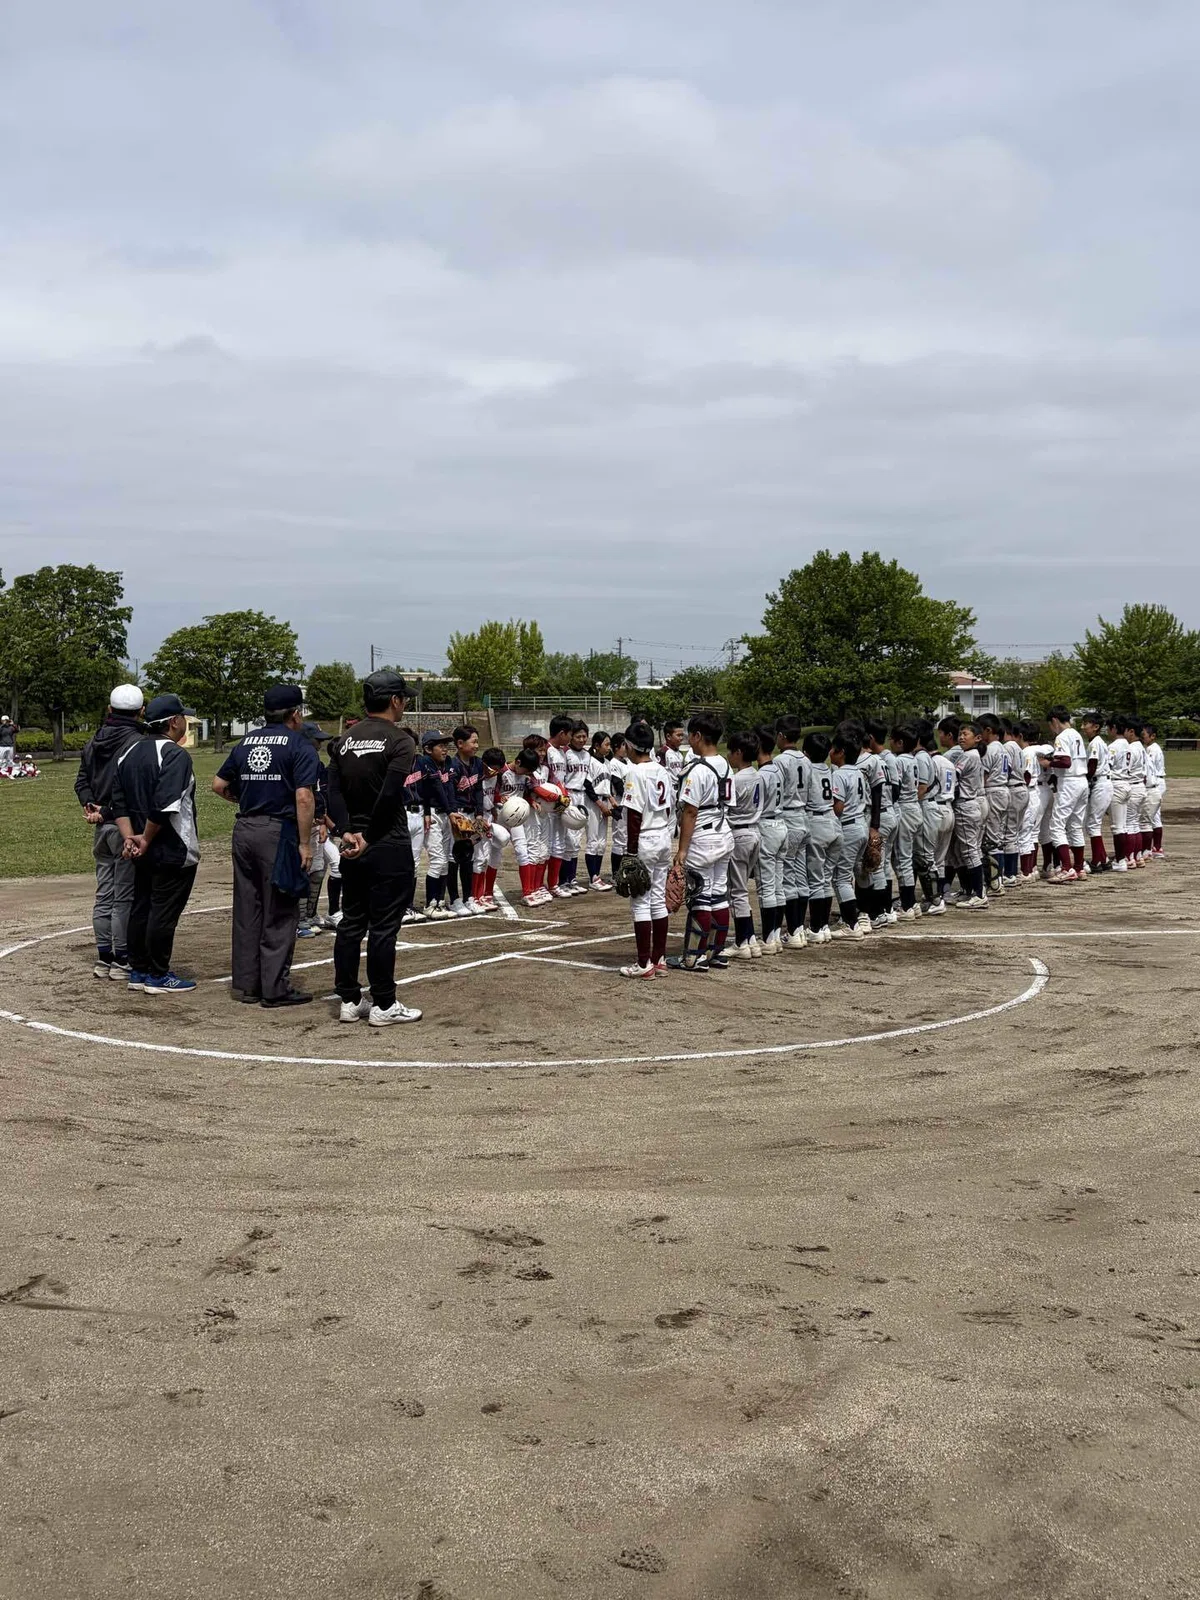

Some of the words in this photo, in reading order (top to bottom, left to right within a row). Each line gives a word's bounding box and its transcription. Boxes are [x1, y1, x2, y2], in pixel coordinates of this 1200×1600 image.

[797, 765, 804, 789] 1
[821, 777, 832, 800] 8
[945, 770, 953, 792] 5
[657, 780, 666, 806] 2
